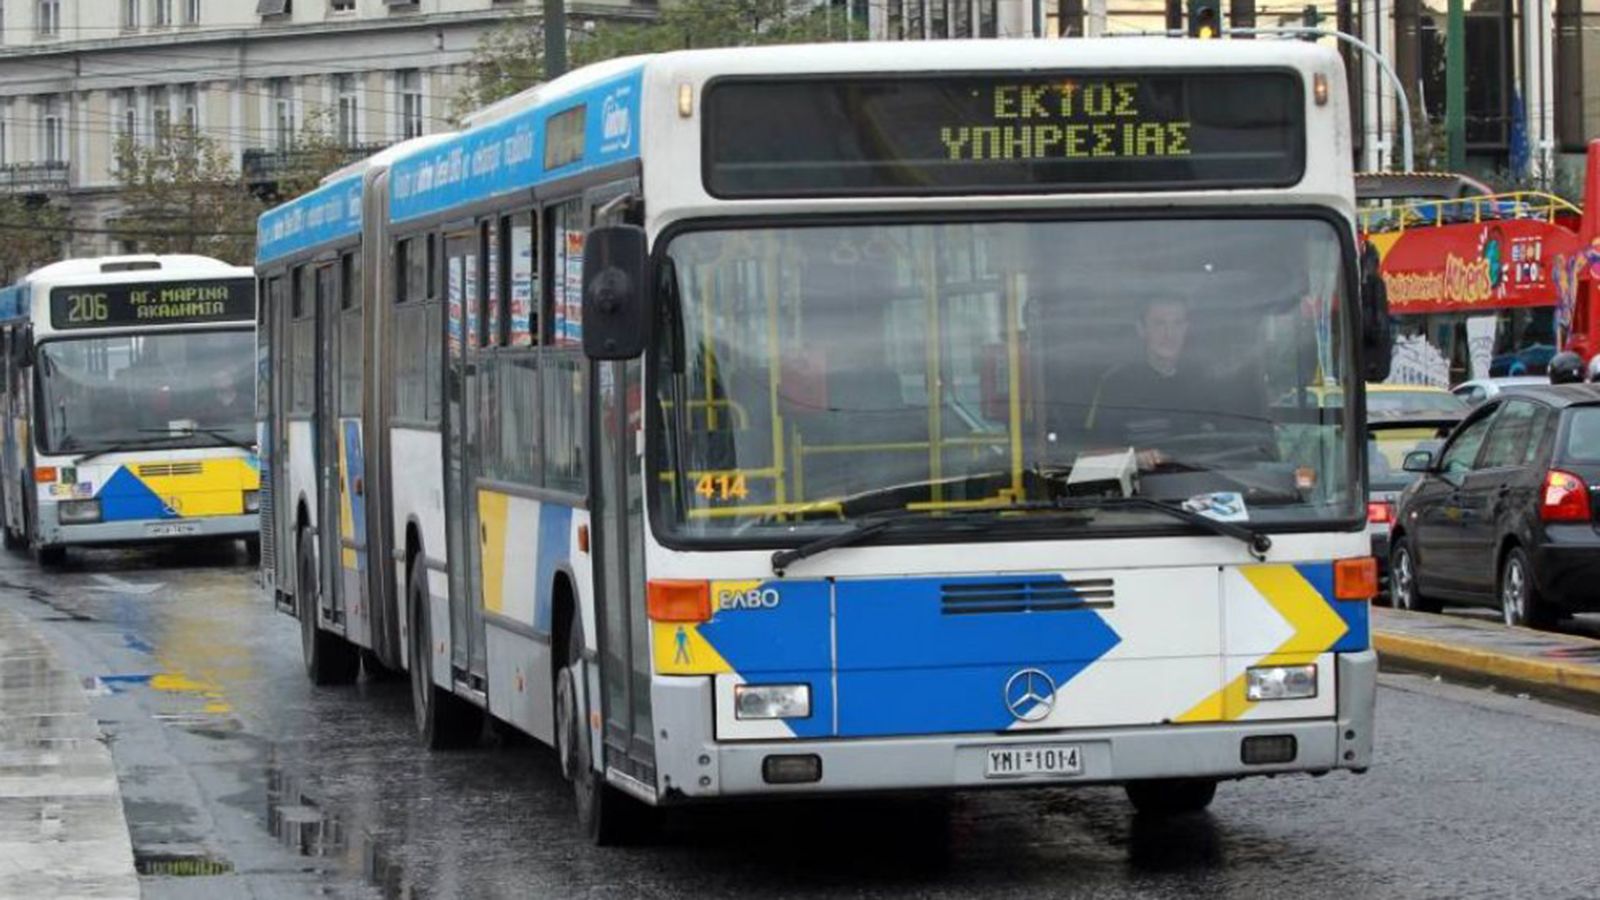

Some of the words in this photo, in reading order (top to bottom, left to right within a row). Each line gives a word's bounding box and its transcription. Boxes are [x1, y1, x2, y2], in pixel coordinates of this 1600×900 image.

[994, 82, 1138, 118] ΕΚΤΟΣ
[941, 121, 1192, 160] ΥΠΗΡΕΣΙΑΣ
[67, 293, 108, 322] 206
[137, 302, 225, 318] ΑΚΑΔΗΜΙΑ
[695, 473, 748, 500] 414
[719, 588, 779, 609] ΕΛΒΟ
